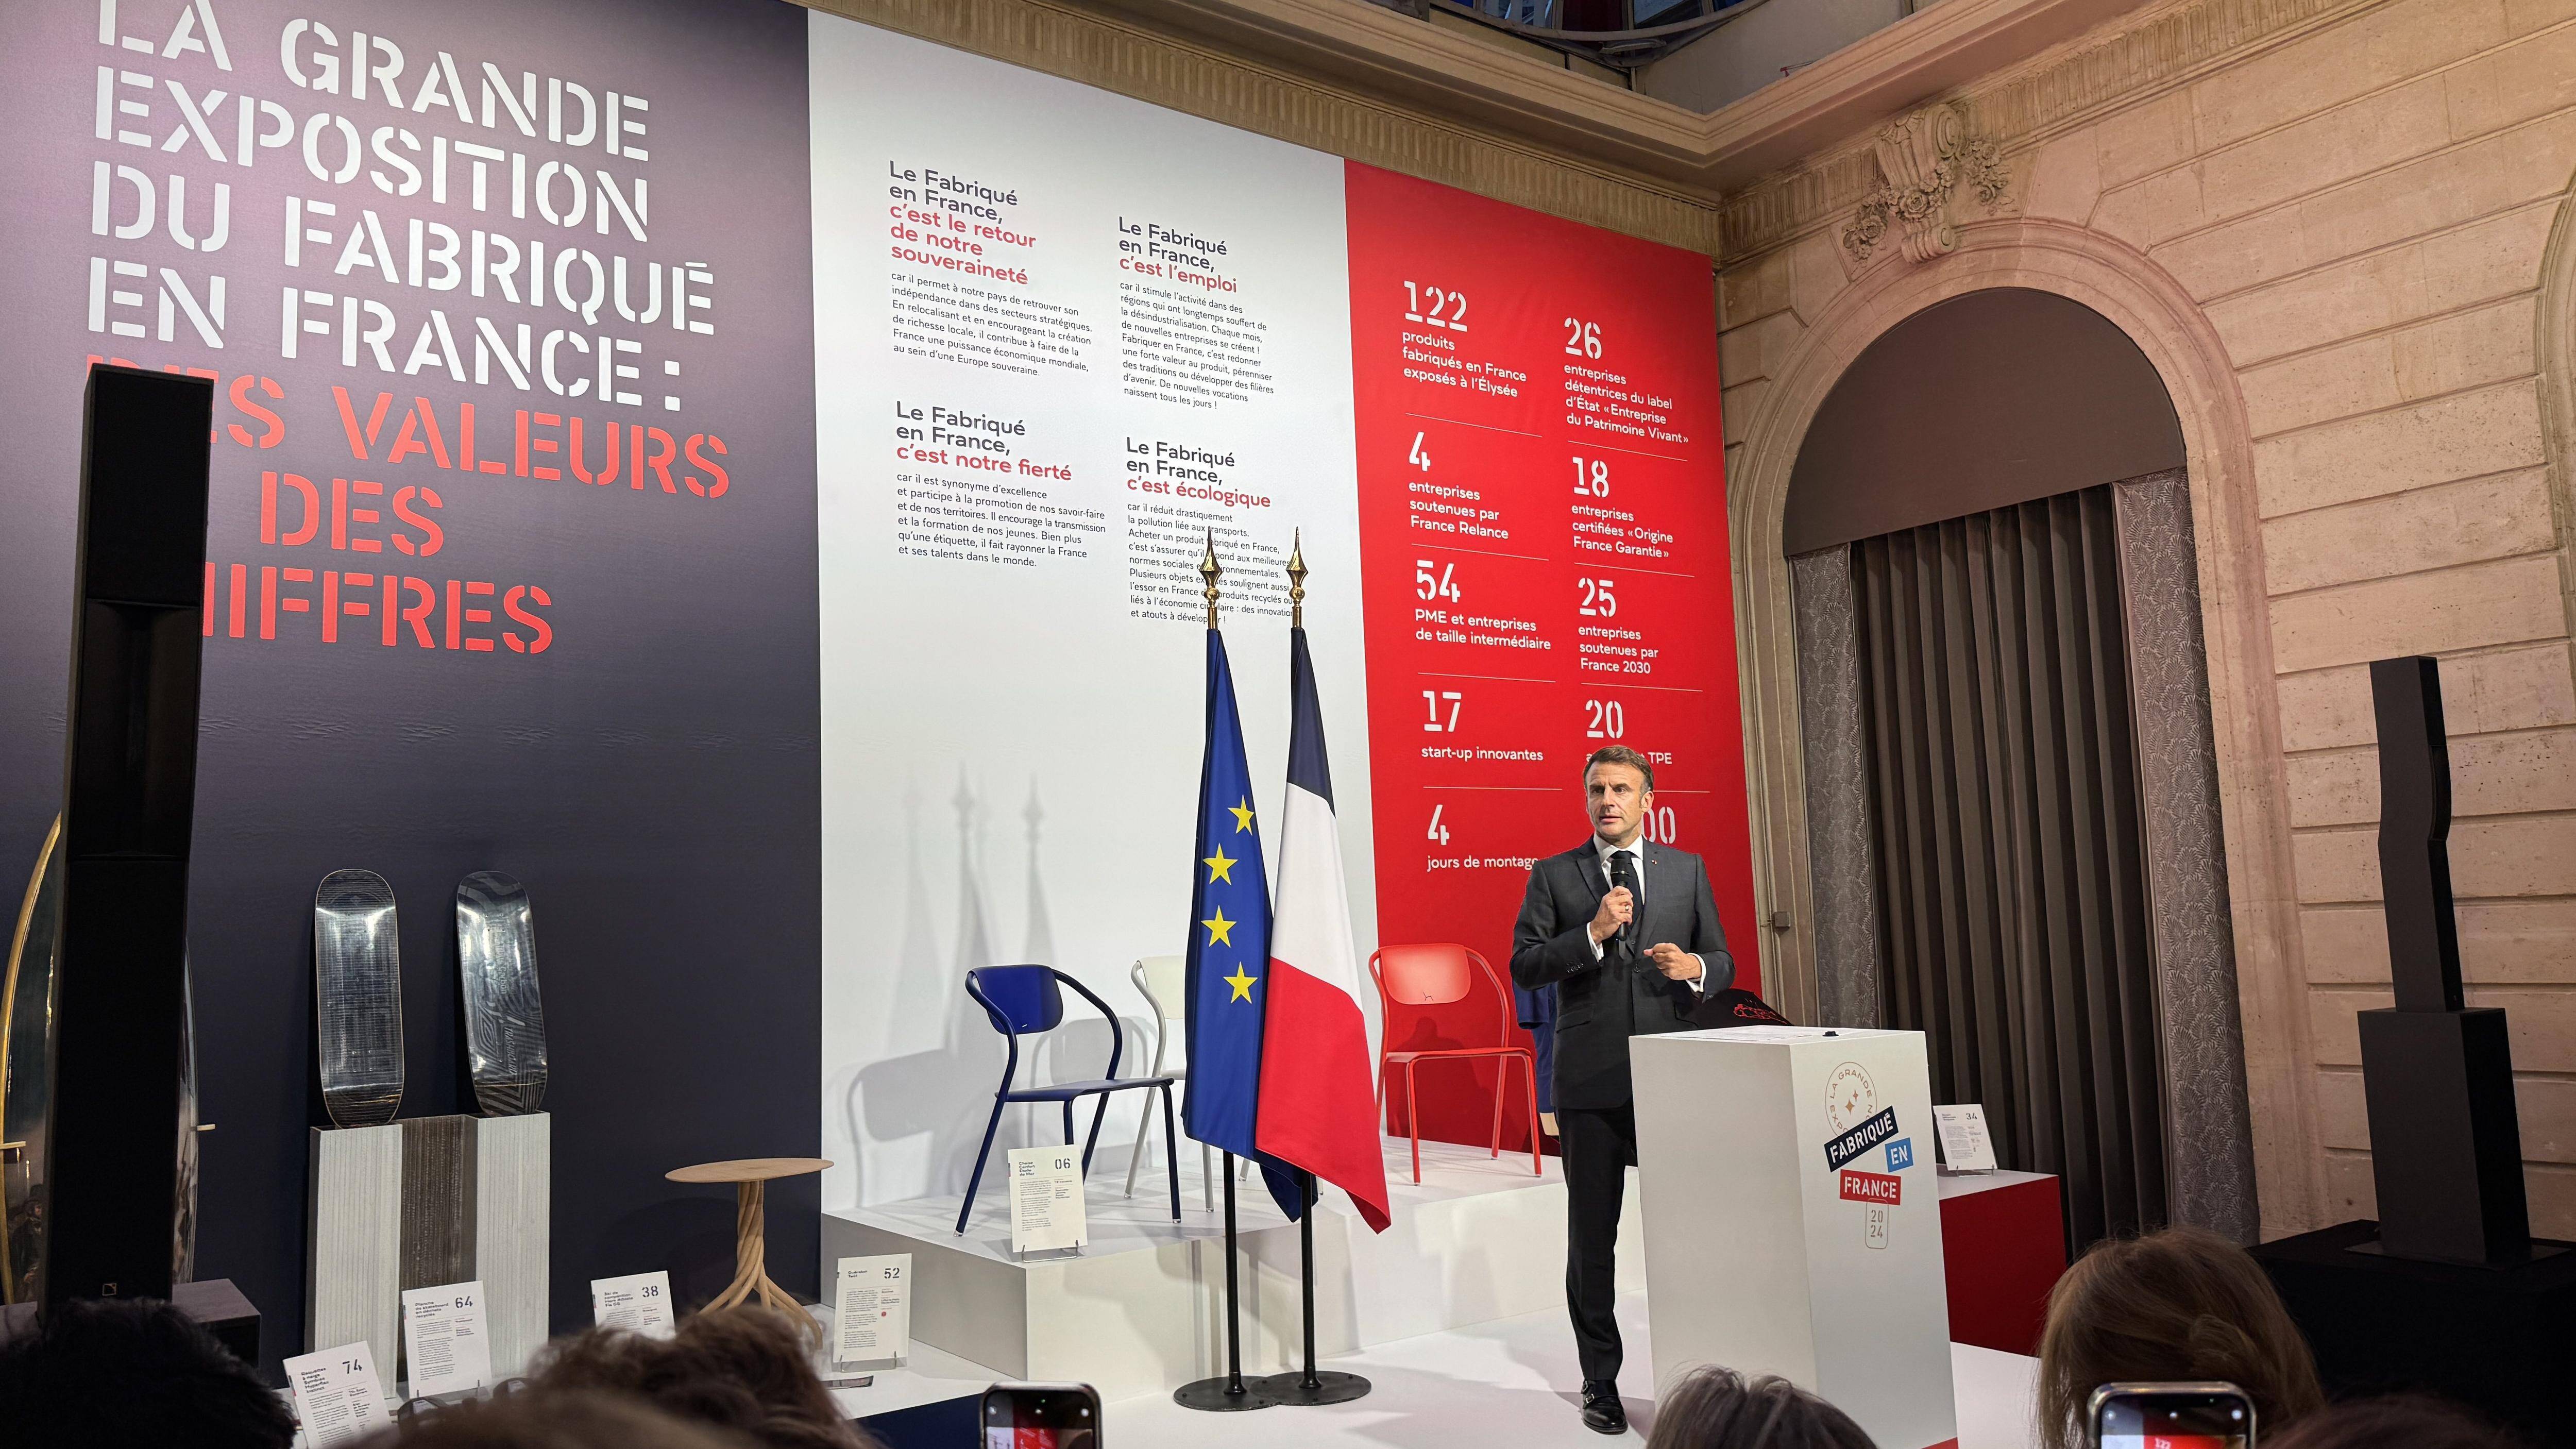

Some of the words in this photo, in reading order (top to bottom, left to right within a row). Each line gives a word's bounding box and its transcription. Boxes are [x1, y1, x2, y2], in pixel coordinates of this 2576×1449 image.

[98, 0, 232, 71] LA
[280, 18, 649, 162] GRANDE
[95, 65, 648, 242] EXPOSITION
[889, 160, 917, 182] Le
[925, 169, 1018, 206] Fabriqué
[889, 186, 917, 203] en
[925, 188, 1003, 225] France,
[890, 222, 919, 242] de
[926, 233, 983, 256] notre
[948, 213, 967, 233] le
[974, 224, 1037, 248] retour
[1118, 216, 1142, 236] Le
[1148, 223, 1227, 256] Fabriqué
[92, 160, 230, 252] DU
[284, 196, 714, 335] FABRIQUÉ
[1118, 239, 1142, 255] en
[1148, 241, 1215, 273] France,
[891, 246, 1028, 285] souveraineté
[88, 257, 226, 349] EN
[891, 273, 906, 282] car
[908, 274, 914, 284] il
[917, 278, 951, 291] permet
[953, 283, 958, 293] à
[961, 287, 985, 298] notre
[987, 292, 1008, 303] pays
[1009, 295, 1021, 305] de
[1023, 299, 1062, 313] retrouver
[1064, 307, 1079, 316] son
[1120, 282, 1133, 291] car
[1135, 283, 1140, 293] il
[1142, 286, 1172, 299] stimule
[1208, 299, 1227, 311] dans
[1229, 303, 1243, 314] des
[1403, 280, 1467, 332] 122
[1402, 331, 1455, 351] produits
[1564, 317, 1602, 360] 26
[1402, 346, 1463, 369] fabriqués
[1465, 362, 1482, 374] en
[1485, 362, 1527, 382] France
[1403, 367, 1457, 386] exposés
[1460, 375, 1468, 388] à
[1564, 364, 1627, 385] entreprises
[1565, 378, 1628, 401] détentrices
[1630, 391, 1645, 405] du
[1647, 394, 1672, 410] label
[896, 400, 924, 421] Le
[932, 406, 1026, 437] Fabriqué
[1566, 412, 1581, 426] du
[1584, 414, 1646, 437] Patrimoine
[331, 385, 730, 498] VALEURS
[896, 426, 924, 442] en
[932, 426, 1010, 457] France,
[1126, 436, 1150, 455] Le
[1156, 441, 1235, 469] Fabriqué
[1408, 431, 1431, 471] 4
[956, 454, 1012, 474] notre
[1018, 458, 1072, 481] fierté
[1126, 460, 1150, 474] en
[1156, 459, 1223, 486] France,
[1572, 457, 1609, 498] 18
[896, 474, 913, 482] car
[915, 473, 921, 484] il
[923, 477, 939, 486] est
[941, 479, 990, 493] synonyme
[1176, 481, 1271, 510] écologique
[1408, 482, 1481, 501] entreprises
[260, 470, 445, 557] DES
[897, 487, 908, 497] et
[910, 490, 953, 503] participe
[955, 493, 961, 503] à
[964, 493, 973, 504] la
[975, 498, 1023, 510] promotion
[1025, 501, 1037, 512] de
[1039, 506, 1056, 514] nos
[1058, 508, 1105, 520] savoir-faire
[1142, 502, 1147, 512] il
[1150, 504, 1174, 516] réduit
[1176, 508, 1233, 523] drastiquement
[1409, 500, 1476, 518] soutenues
[1479, 510, 1500, 522] par
[1571, 504, 1634, 522] entreprises
[1128, 514, 1136, 524] la
[1138, 516, 1173, 529] pollution
[1175, 520, 1190, 530] liée
[1191, 524, 1206, 532] aux
[1211, 527, 1249, 537] ransports.
[1411, 514, 1455, 533] France
[1459, 520, 1509, 540] Relance
[1572, 521, 1624, 537] certifiées
[1573, 535, 1613, 552] France
[1416, 560, 1461, 603] 54
[1578, 577, 1617, 617] 25
[1415, 608, 1447, 624] PME
[1451, 614, 1465, 626] et
[1467, 616, 1537, 632] entreprises
[1578, 625, 1641, 641] entreprises
[1415, 627, 1433, 641] de
[1435, 629, 1467, 644] taille
[1470, 631, 1551, 650] intermédiaire
[1579, 643, 1638, 657] soutenues
[1640, 648, 1659, 661] par
[1580, 657, 1620, 672] France
[1622, 660, 1651, 675] 2030
[1422, 690, 1462, 732] 17
[1585, 699, 1623, 739] 20
[1421, 746, 1473, 762] start-up
[1476, 746, 1544, 761] innovantes
[1647, 752, 1673, 765] TPE
[1427, 804, 1450, 846] 4
[1426, 855, 1460, 872] jours
[1463, 854, 1480, 868] de
[1838, 1069, 1872, 1099] GRANDE
[1829, 1111, 1894, 1164] FABRIQUÉ
[1055, 1158, 1071, 1170] 06
[1890, 1145, 1908, 1165] EN
[1844, 1176, 1897, 1199] FRANCE
[1871, 1209, 1884, 1223] 20
[1870, 1224, 1883, 1239] 24
[884, 1267, 900, 1279] 52
[455, 1295, 473, 1309] 64
[641, 1285, 659, 1298] 38
[342, 1358, 363, 1374] 74
